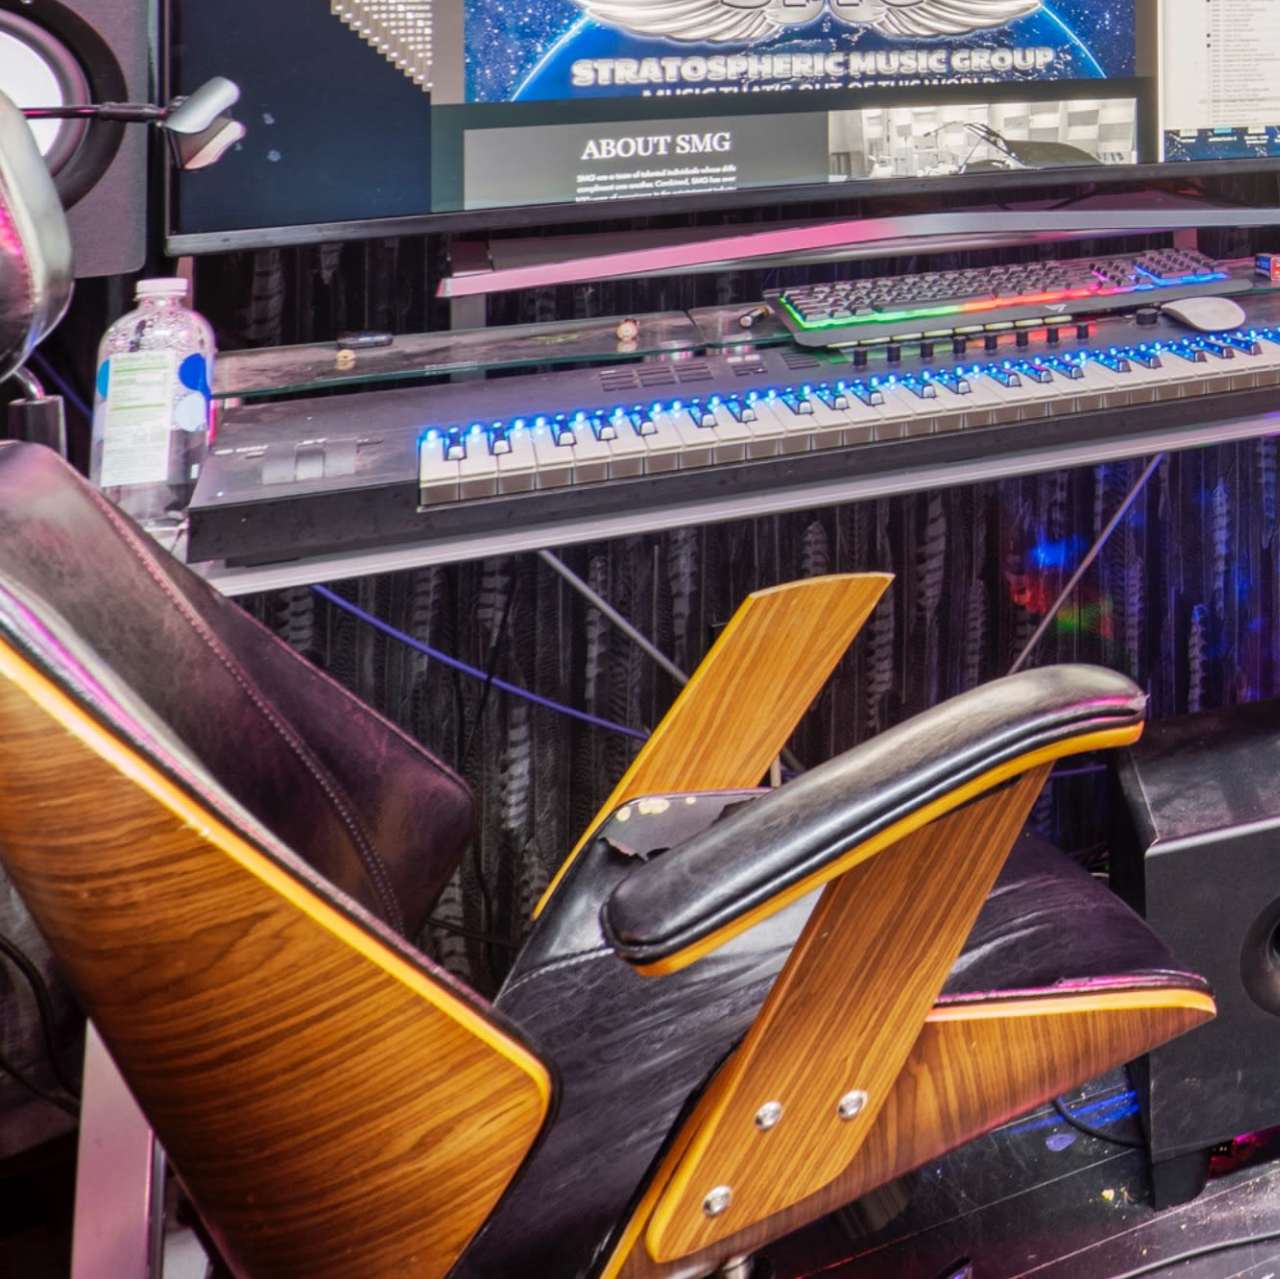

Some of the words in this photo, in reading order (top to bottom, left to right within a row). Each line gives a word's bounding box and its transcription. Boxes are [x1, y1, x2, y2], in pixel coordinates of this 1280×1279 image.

[571, 53, 845, 86] STRATOSPHERIC
[850, 49, 947, 76] MUSIC
[950, 47, 1055, 71] GROUP
[581, 135, 671, 160] ABOUT
[676, 132, 731, 154] SMG
